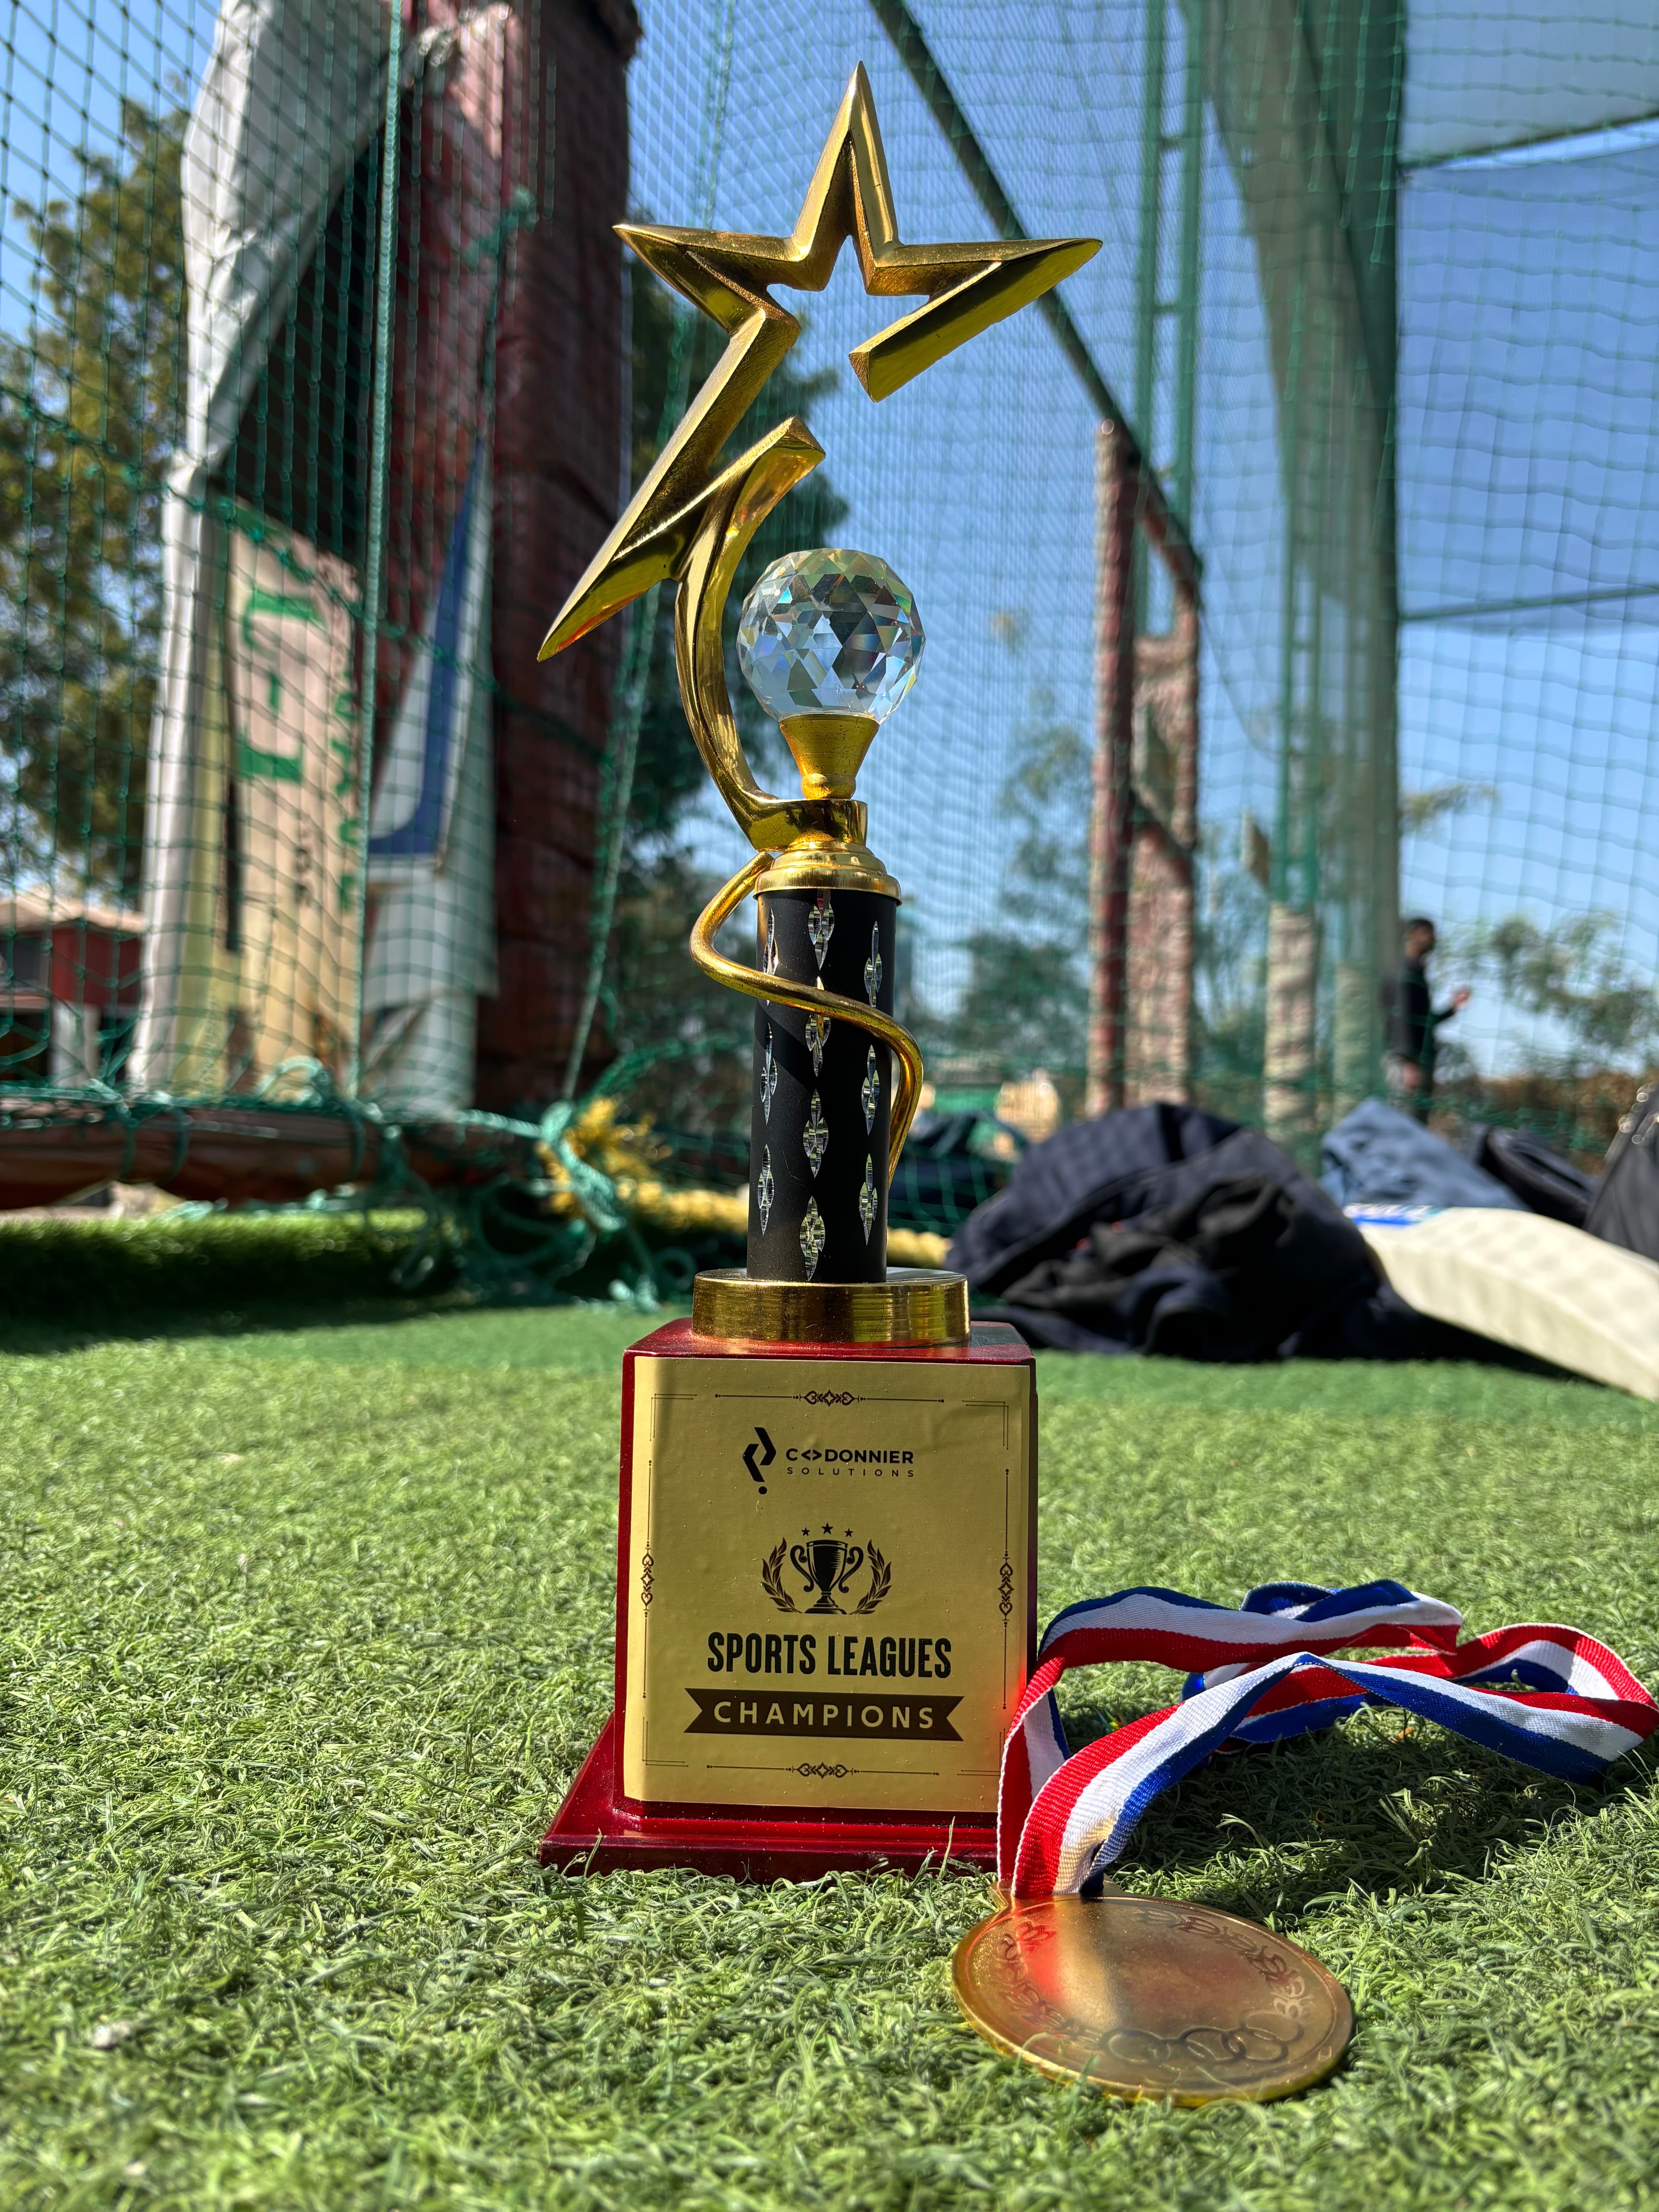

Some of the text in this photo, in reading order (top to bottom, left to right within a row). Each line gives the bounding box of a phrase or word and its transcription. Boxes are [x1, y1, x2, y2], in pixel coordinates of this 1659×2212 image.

[787, 1467, 914, 1478] SOLUTIONS
[707, 1631, 952, 1679] SPORTS LEAGUES
[714, 1701, 934, 1729] CHAMPIONS
